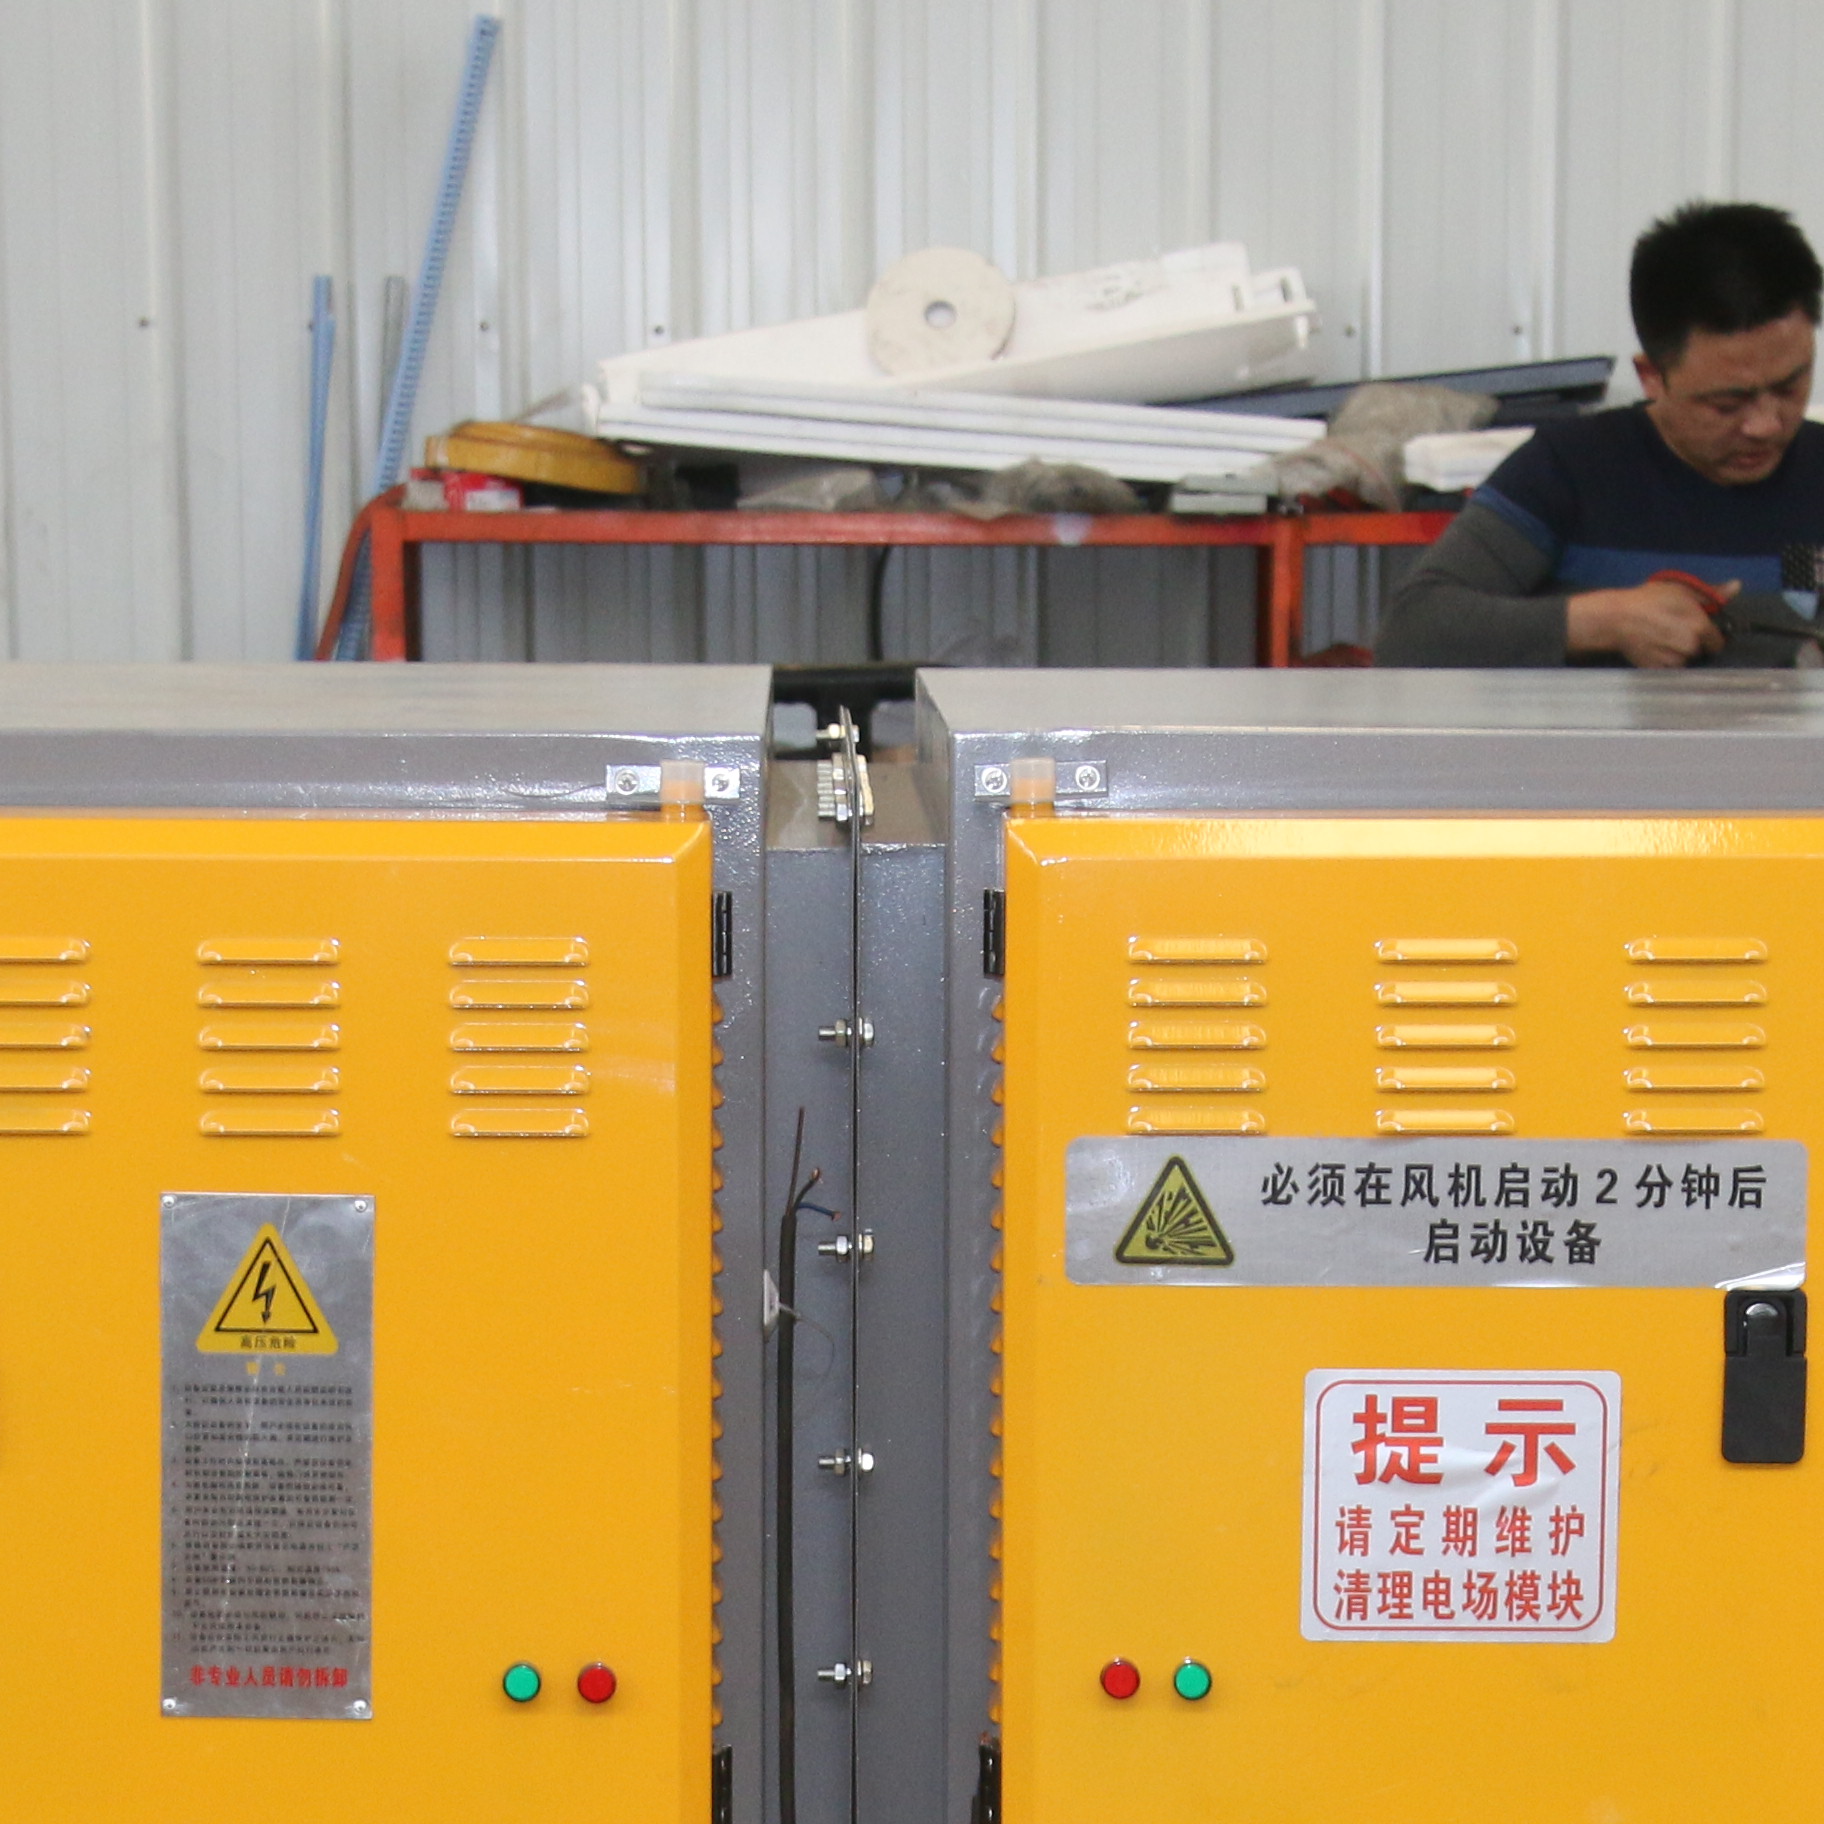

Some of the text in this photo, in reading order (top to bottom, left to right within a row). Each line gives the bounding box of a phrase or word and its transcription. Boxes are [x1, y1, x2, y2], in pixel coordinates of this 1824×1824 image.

[1262, 1162, 1767, 1209] 必须在风机启动2分钟后
[1424, 1219, 1602, 1265] 启动设备
[1351, 1394, 1578, 1487] 提示
[1335, 1504, 1586, 1557] 请定期维护
[1334, 1569, 1584, 1622] 清理电场模块
[189, 1664, 349, 1688] 非专业人员请勿拆卸
